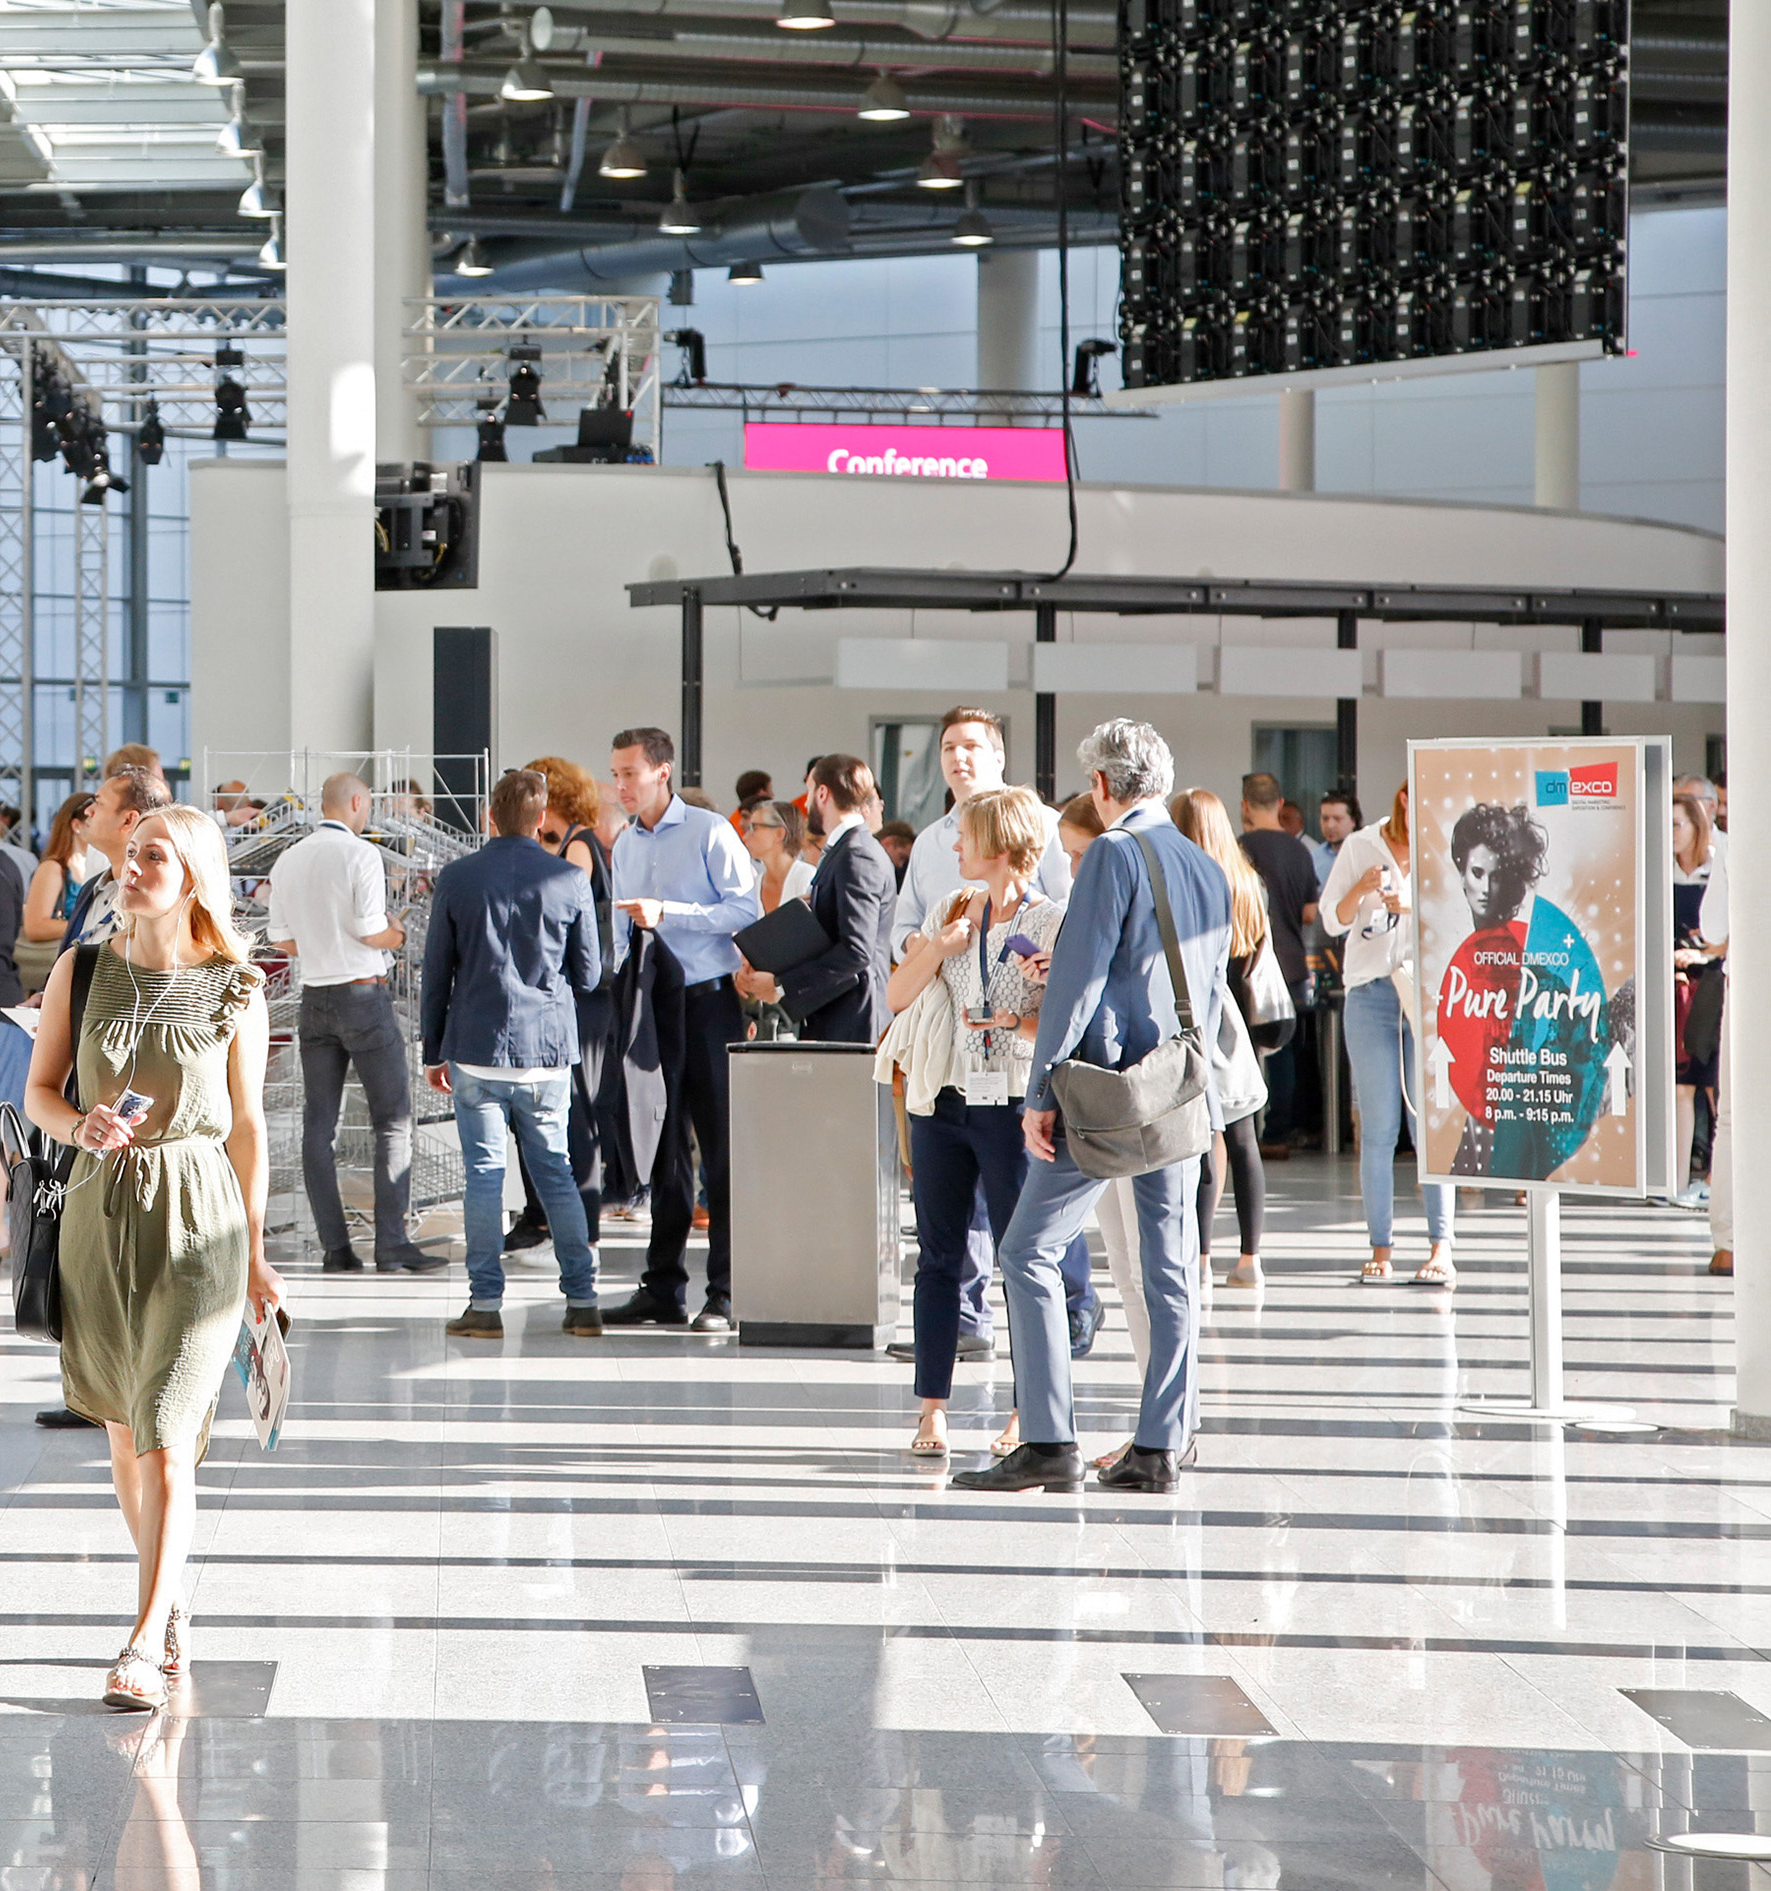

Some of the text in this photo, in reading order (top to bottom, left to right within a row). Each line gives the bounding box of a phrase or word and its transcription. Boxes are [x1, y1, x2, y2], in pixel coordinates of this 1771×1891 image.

[827, 447, 989, 479] Conference
[1473, 951, 1570, 966] OFFICIAL DMEXCO
[1445, 965, 1602, 1045] Pure Party
[1489, 1046, 1568, 1067] Shuttle Bus
[1486, 1068, 1572, 1086] Departure Times
[1485, 1087, 1514, 1102] 20.00
[1522, 1088, 1552, 1104] 21.15
[1553, 1089, 1574, 1104] Uhr
[1485, 1105, 1493, 1120] 8
[1494, 1108, 1517, 1123] p.m.
[1526, 1107, 1549, 1122] 9:15
[1550, 1110, 1575, 1125] p.m.
